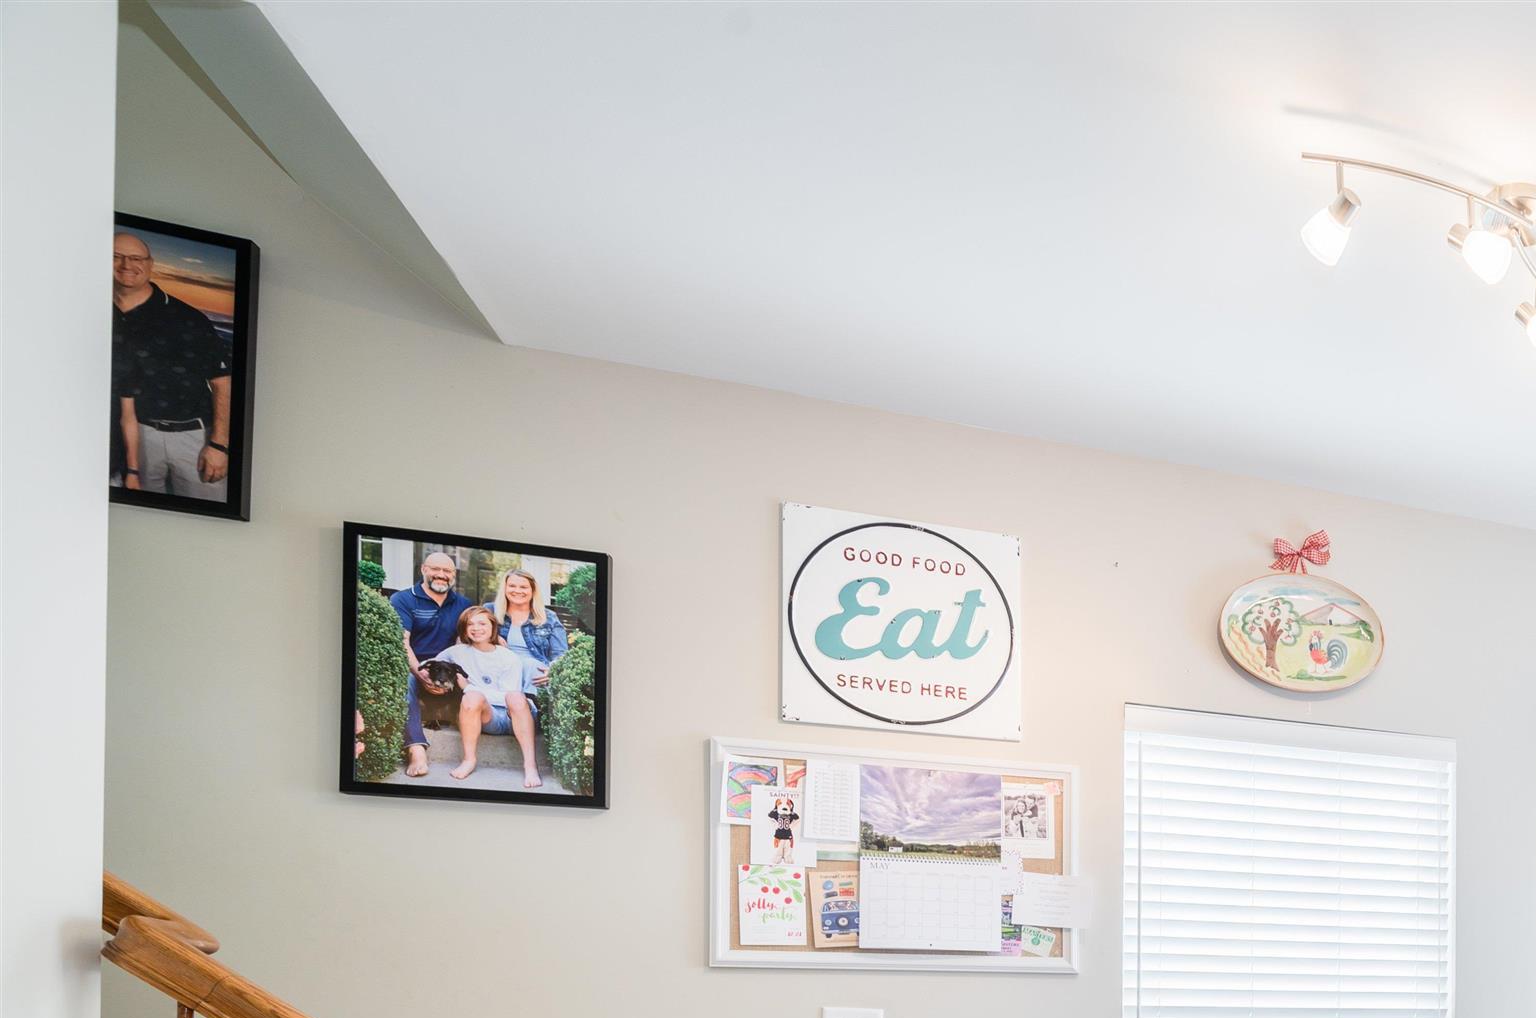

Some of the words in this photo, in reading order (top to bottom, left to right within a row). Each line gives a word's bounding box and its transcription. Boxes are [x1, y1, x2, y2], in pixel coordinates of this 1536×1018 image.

[843, 546, 903, 567] GOOD
[911, 556, 967, 576] FOOD
[814, 576, 989, 660] Eat
[836, 673, 912, 694] SERVED
[920, 683, 967, 701] HERE
[869, 862, 890, 870] MAY
[744, 897, 776, 914] jolly
